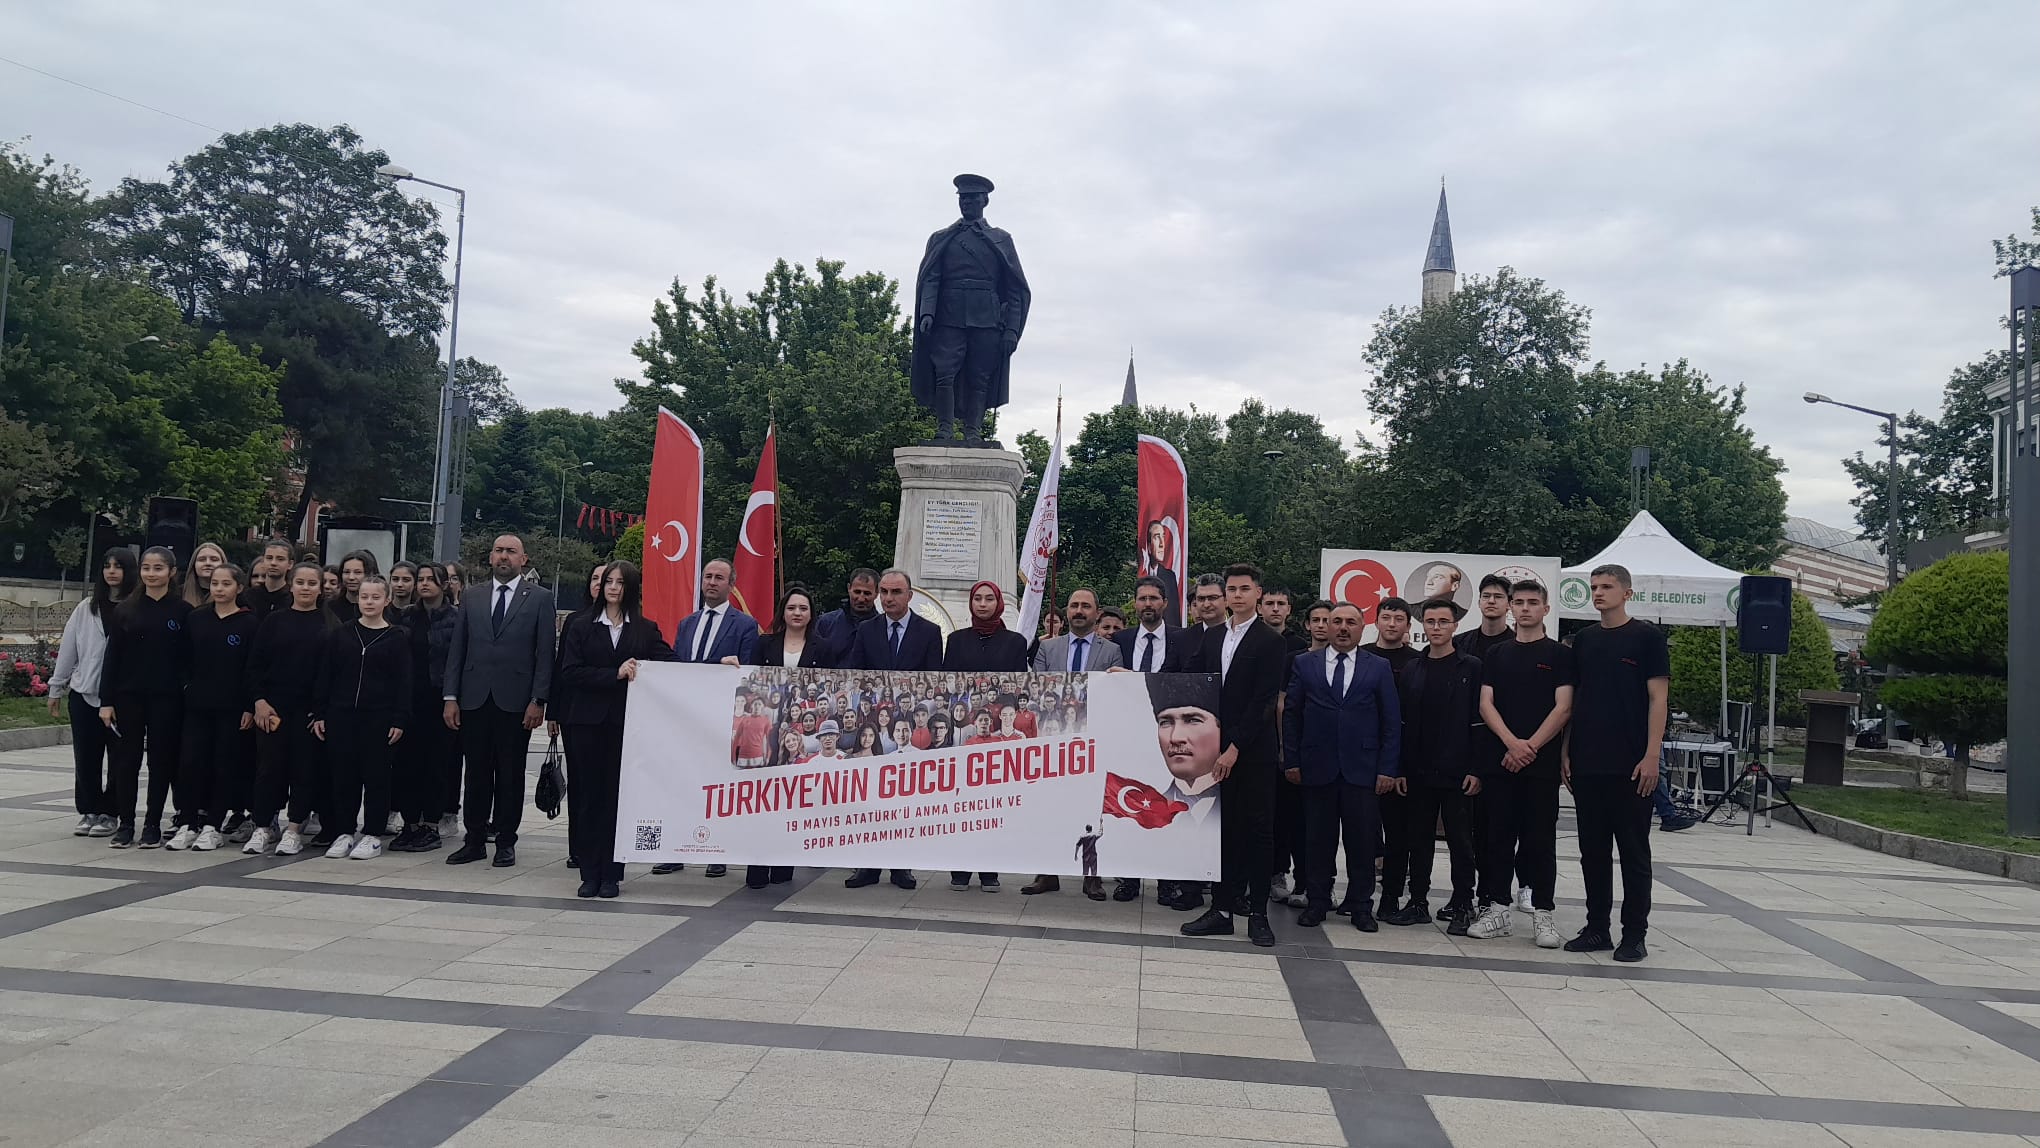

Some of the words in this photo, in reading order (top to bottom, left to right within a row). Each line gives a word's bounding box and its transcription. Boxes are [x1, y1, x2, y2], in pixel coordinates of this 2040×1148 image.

[1651, 591, 1706, 605] BELEDİYESİ
[702, 767, 869, 819] TÜRKİYE'NİN
[878, 756, 961, 799] GÜCÜ,
[966, 737, 1095, 784] GENÇLİĞİ
[786, 820, 799, 833] 19
[803, 815, 841, 831] MAYIS
[845, 806, 911, 826] ATATÜRK'Ü
[915, 803, 950, 818] ANMA
[1008, 794, 1023, 808] VE
[803, 836, 835, 850] SPOR
[839, 824, 916, 847] BAYRAMIMIZ
[919, 820, 957, 837] KUTLU
[961, 816, 1005, 832] OLSUN!
